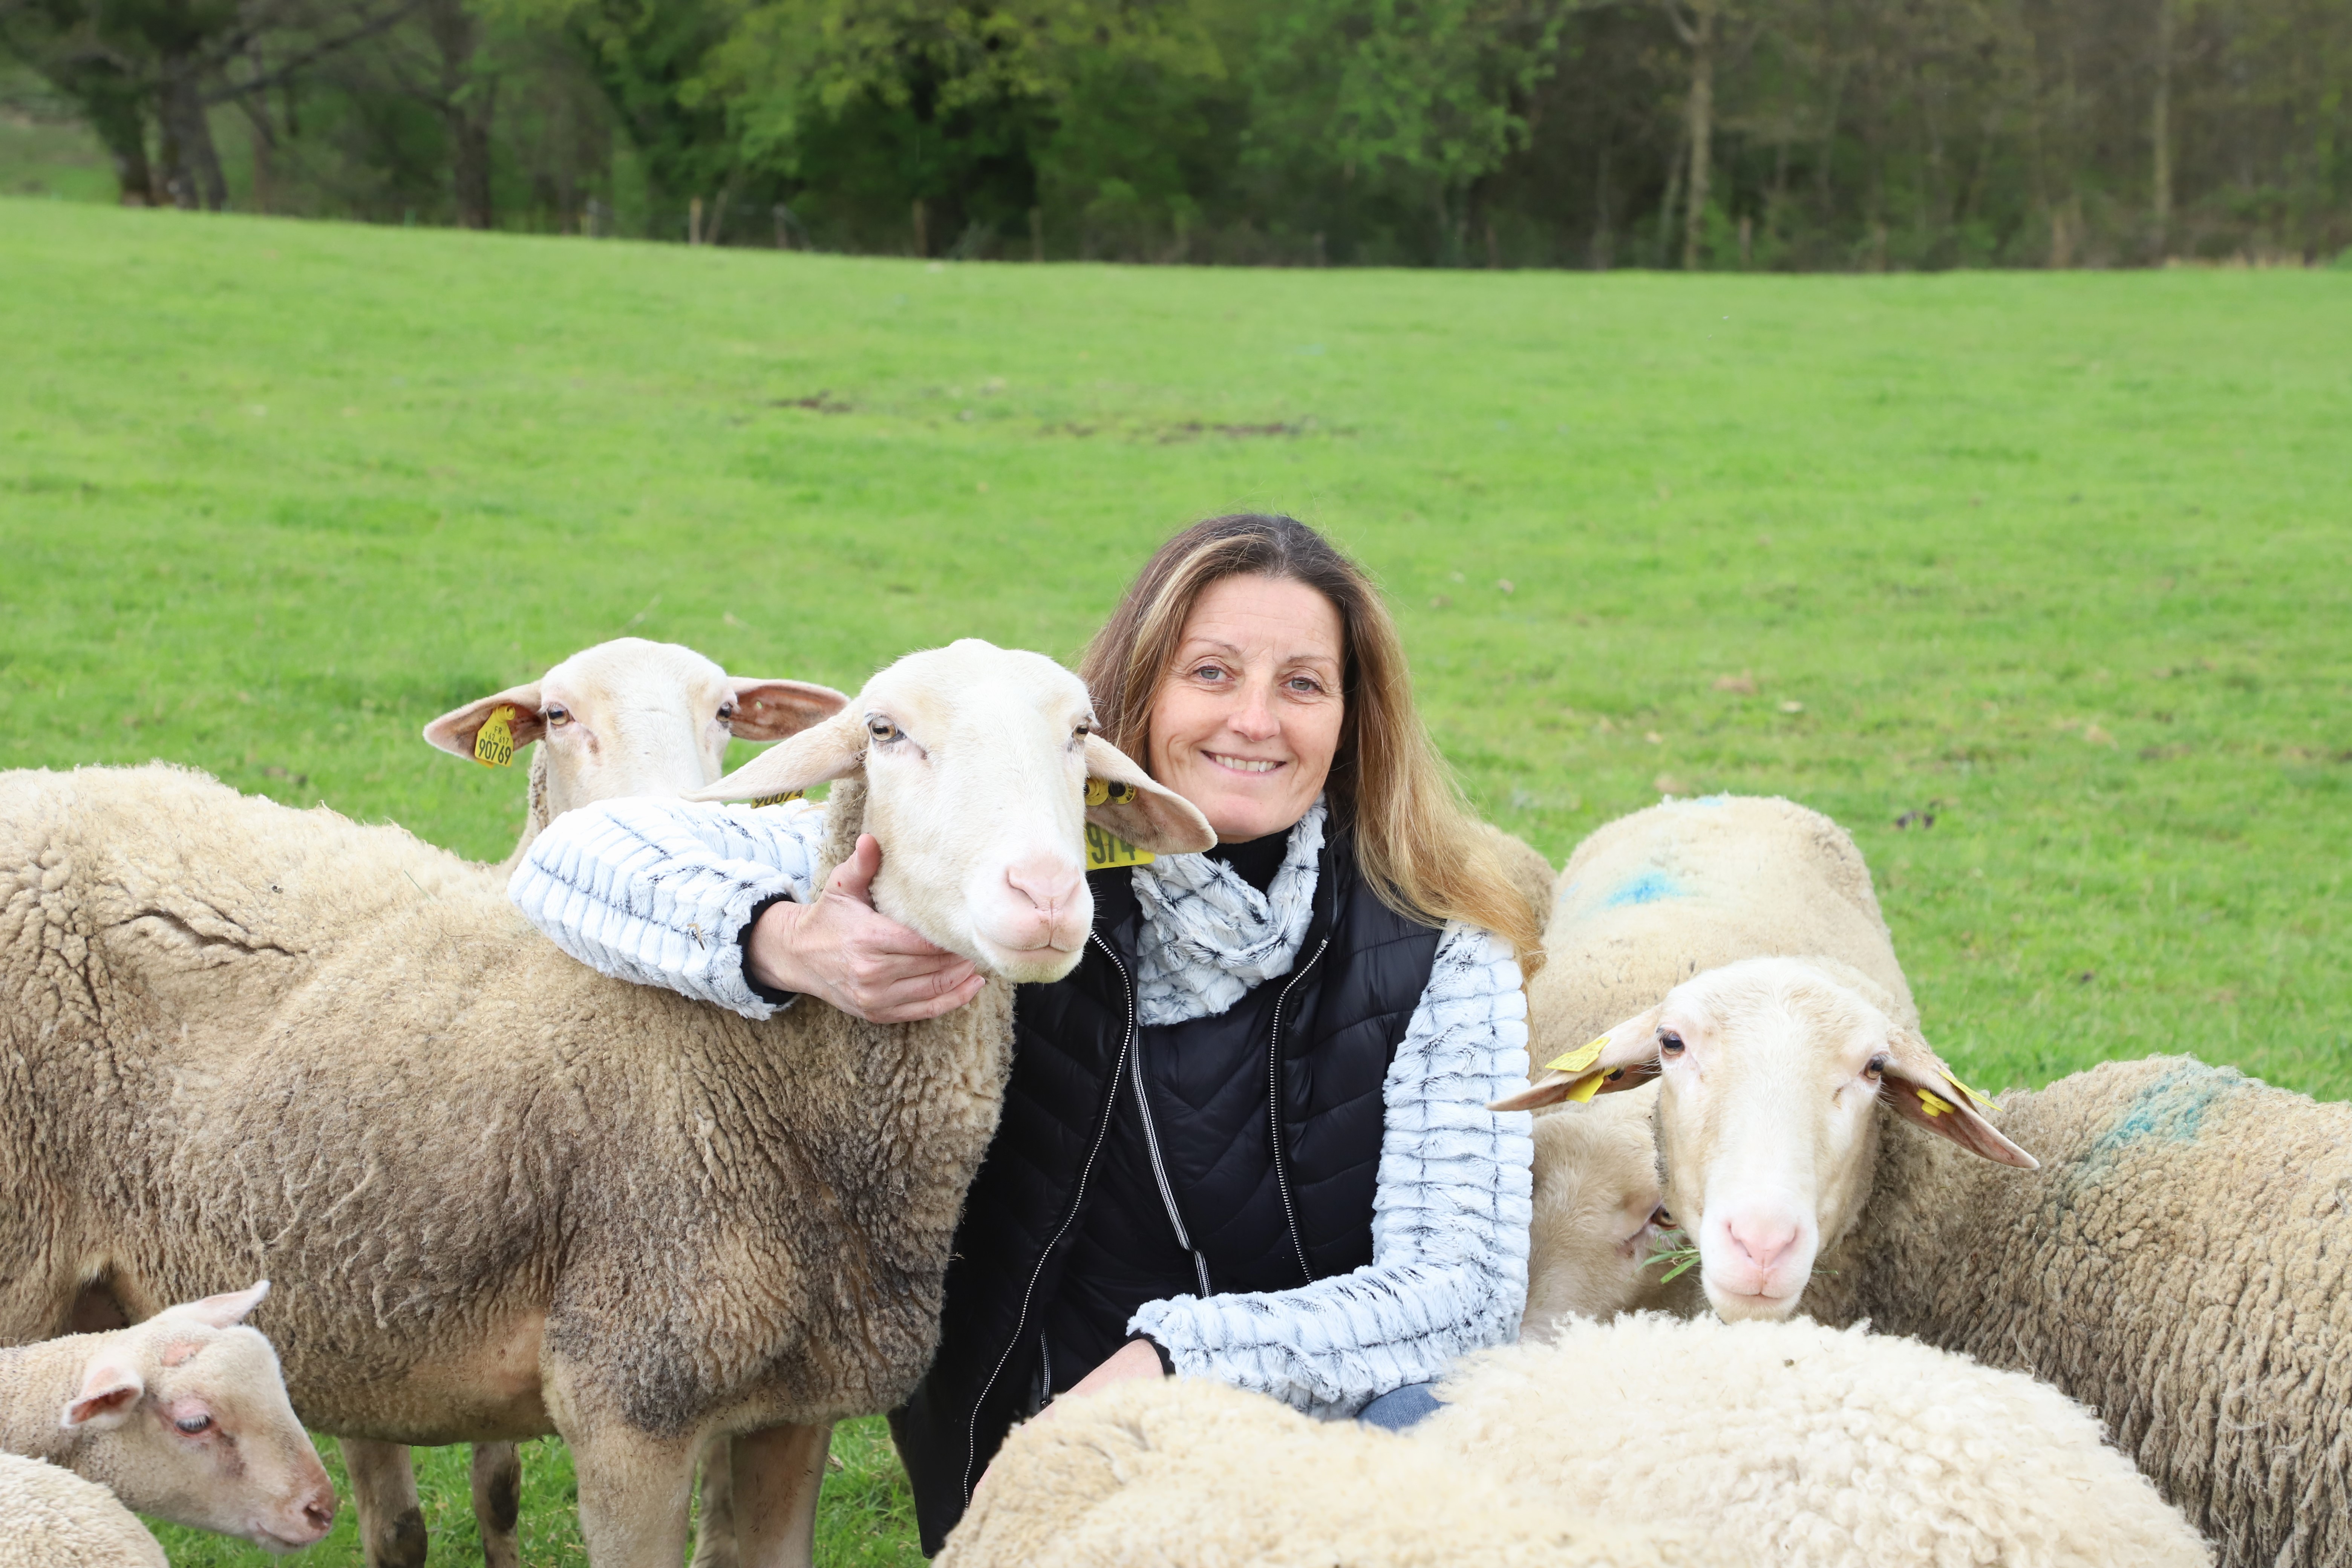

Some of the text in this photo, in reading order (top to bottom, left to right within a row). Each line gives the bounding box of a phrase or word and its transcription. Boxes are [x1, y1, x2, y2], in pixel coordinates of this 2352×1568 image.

[495, 726, 502, 735] FR
[485, 731, 509, 745] 162 617
[479, 738, 511, 765] 90769
[1548, 1057, 1591, 1069] 02120
